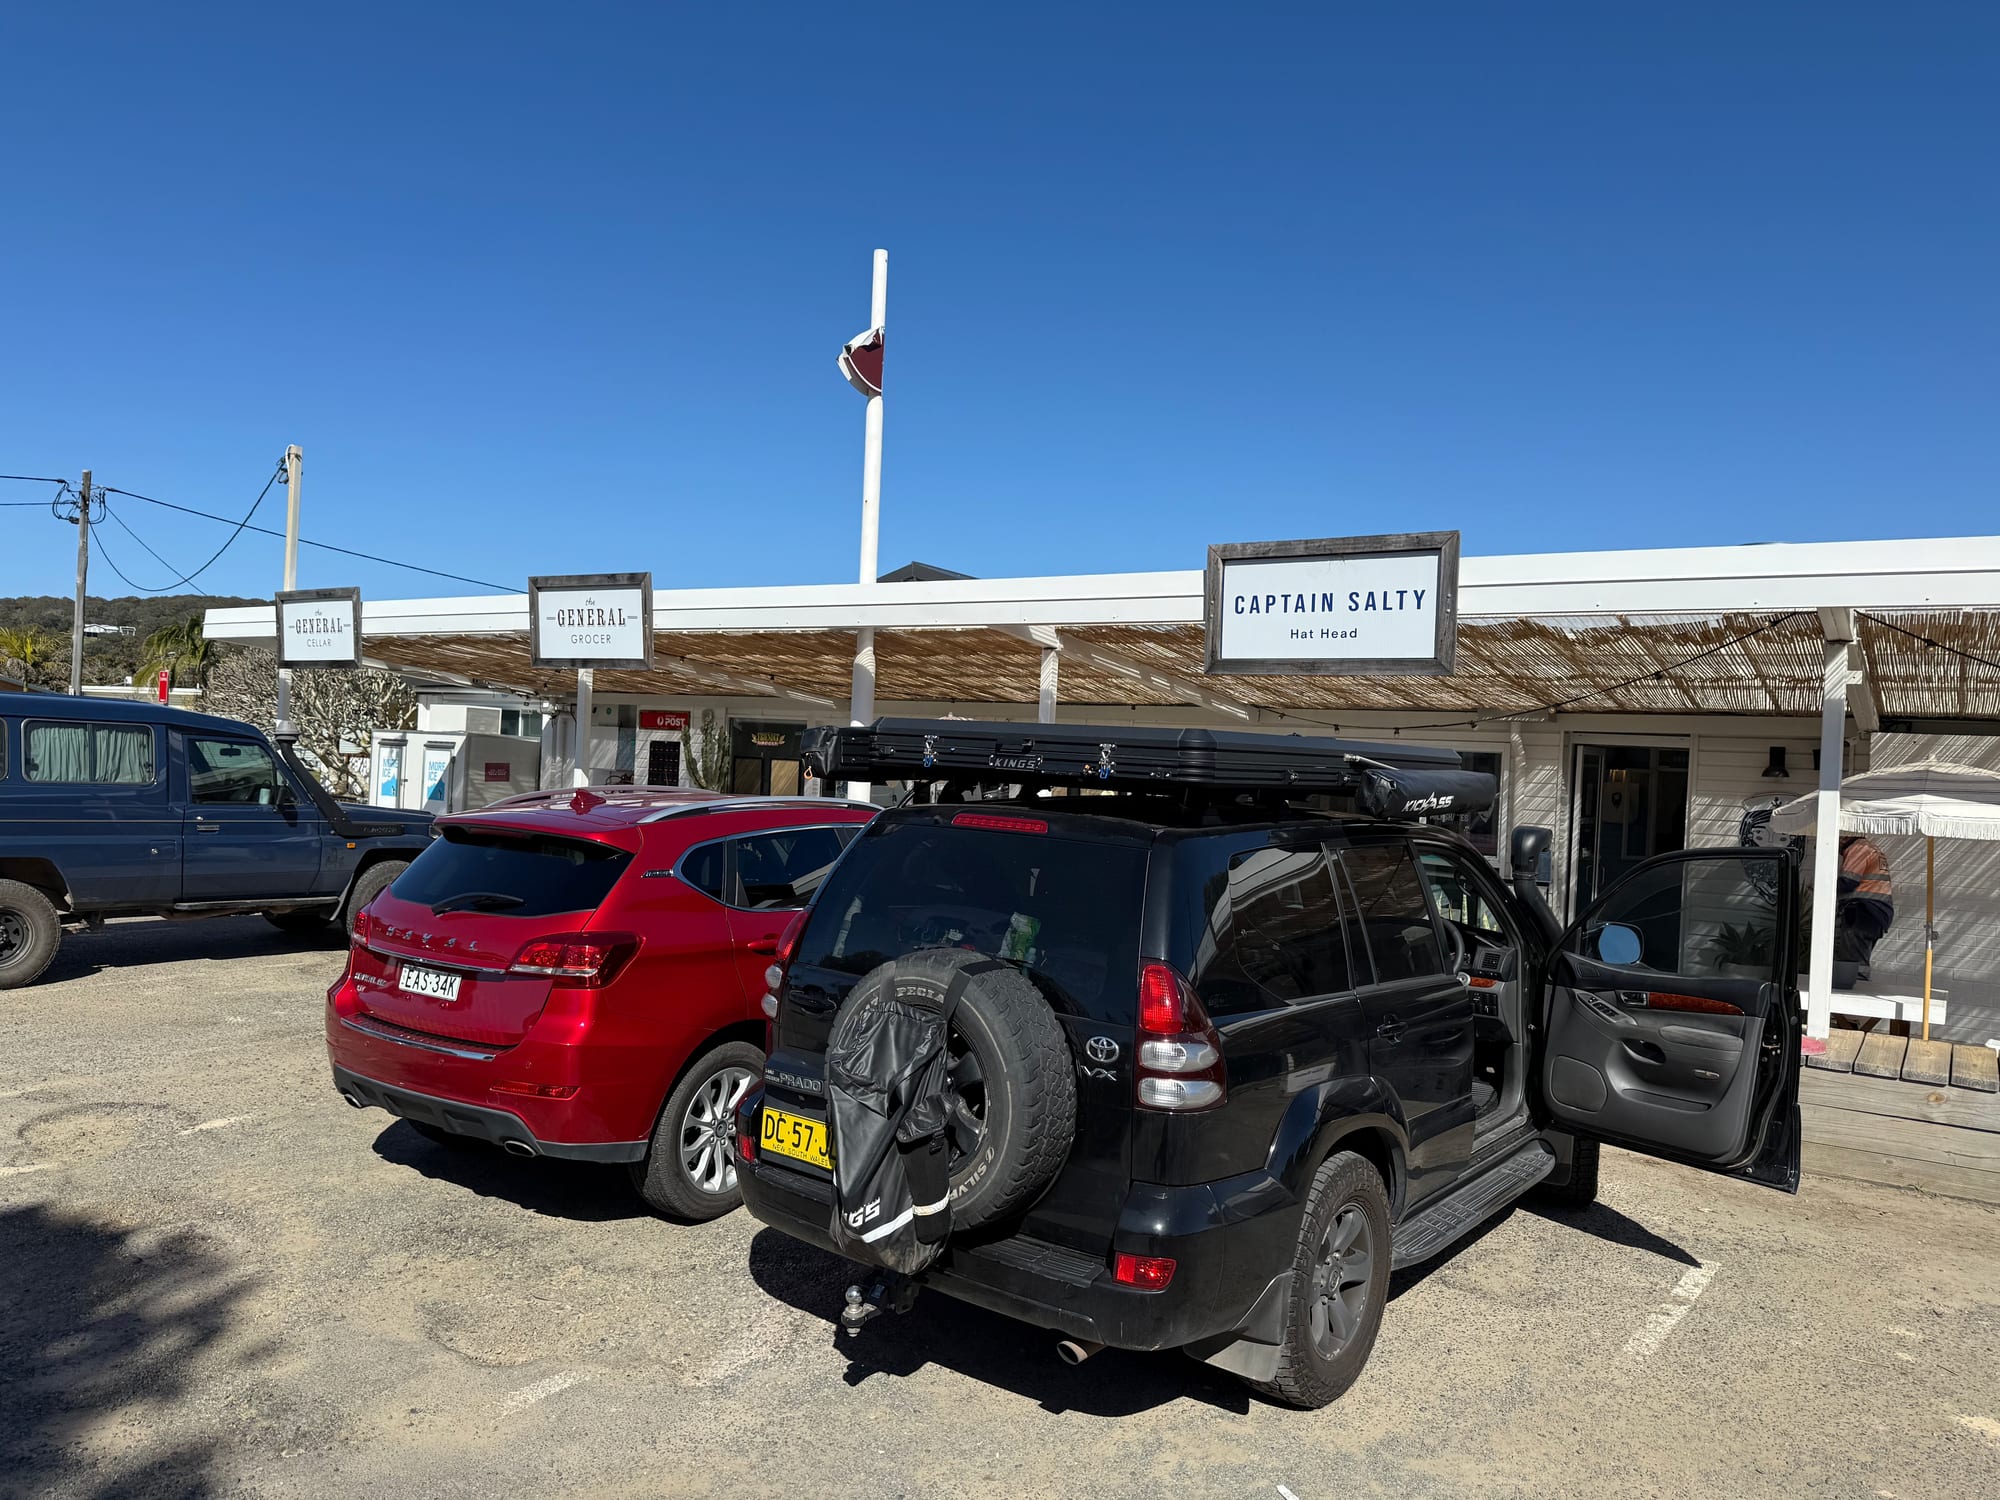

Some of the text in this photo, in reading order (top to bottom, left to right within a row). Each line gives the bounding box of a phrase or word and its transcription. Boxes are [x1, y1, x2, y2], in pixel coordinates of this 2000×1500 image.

[1234, 589, 1426, 615] CAPTAIN SALTY
[557, 607, 626, 627] GENERAL
[295, 617, 343, 635] GENERAL
[570, 634, 611, 644] GROCER
[1290, 628, 1358, 639] Hat Head
[306, 639, 331, 647] CELLAR
[664, 718, 686, 726] POST
[428, 761, 445, 771] MORE
[994, 758, 1036, 769] KINGS
[382, 768, 392, 777] ICE
[428, 771, 438, 781] ICE
[1401, 792, 1454, 814] KICKASS
[386, 926, 480, 952] HAVAL
[1080, 1065, 1117, 1081] VX
[780, 1072, 821, 1091] PRADO
[773, 1143, 785, 1153] NEW
[788, 1148, 807, 1159] SOUTH
